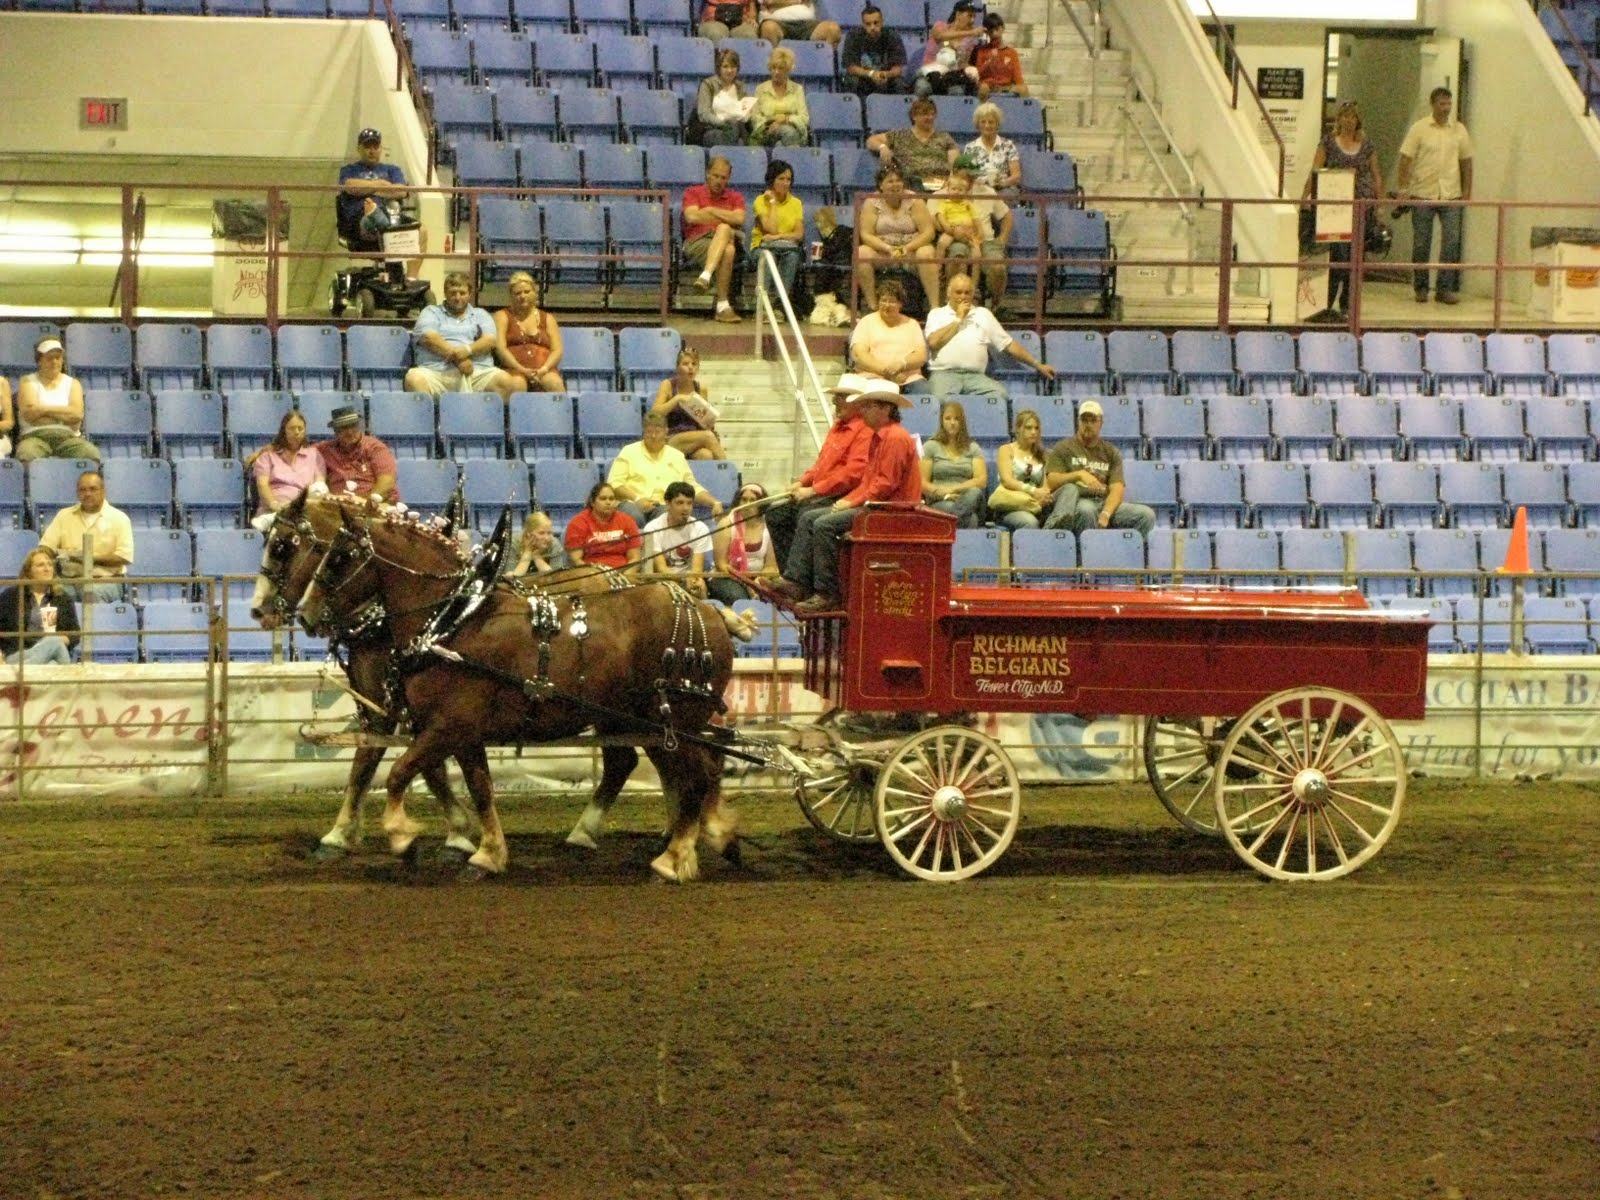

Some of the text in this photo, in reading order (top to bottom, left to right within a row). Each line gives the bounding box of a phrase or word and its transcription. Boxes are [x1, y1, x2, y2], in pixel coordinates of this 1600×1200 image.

[87, 103, 120, 124] EXIT
[973, 634, 1068, 656] RICHMAN
[969, 656, 1071, 676] BELGIANS
[975, 679, 1010, 693] Tower
[1426, 679, 1549, 706] COTAH
